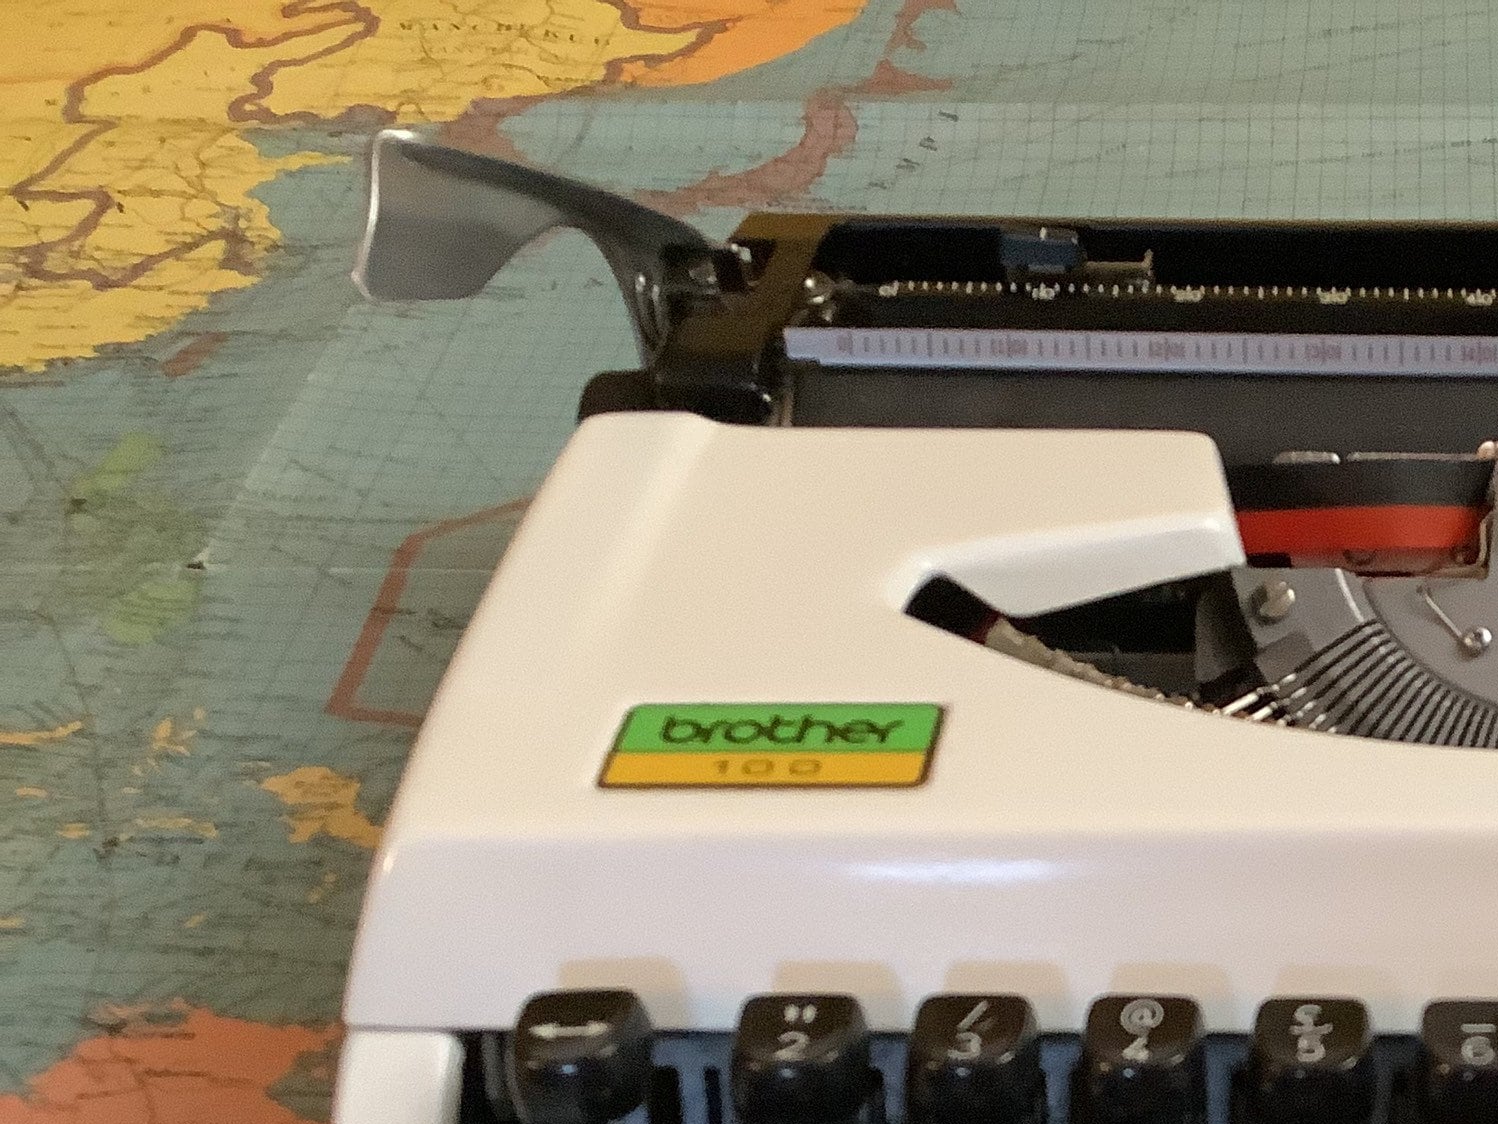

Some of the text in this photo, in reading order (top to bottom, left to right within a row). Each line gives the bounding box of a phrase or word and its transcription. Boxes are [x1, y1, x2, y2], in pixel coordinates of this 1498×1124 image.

[660, 712, 905, 745] brother
[714, 758, 823, 777] 100
[772, 1030, 809, 1062] 2
[947, 1032, 982, 1061] 3
[1460, 1035, 1496, 1066] 6
